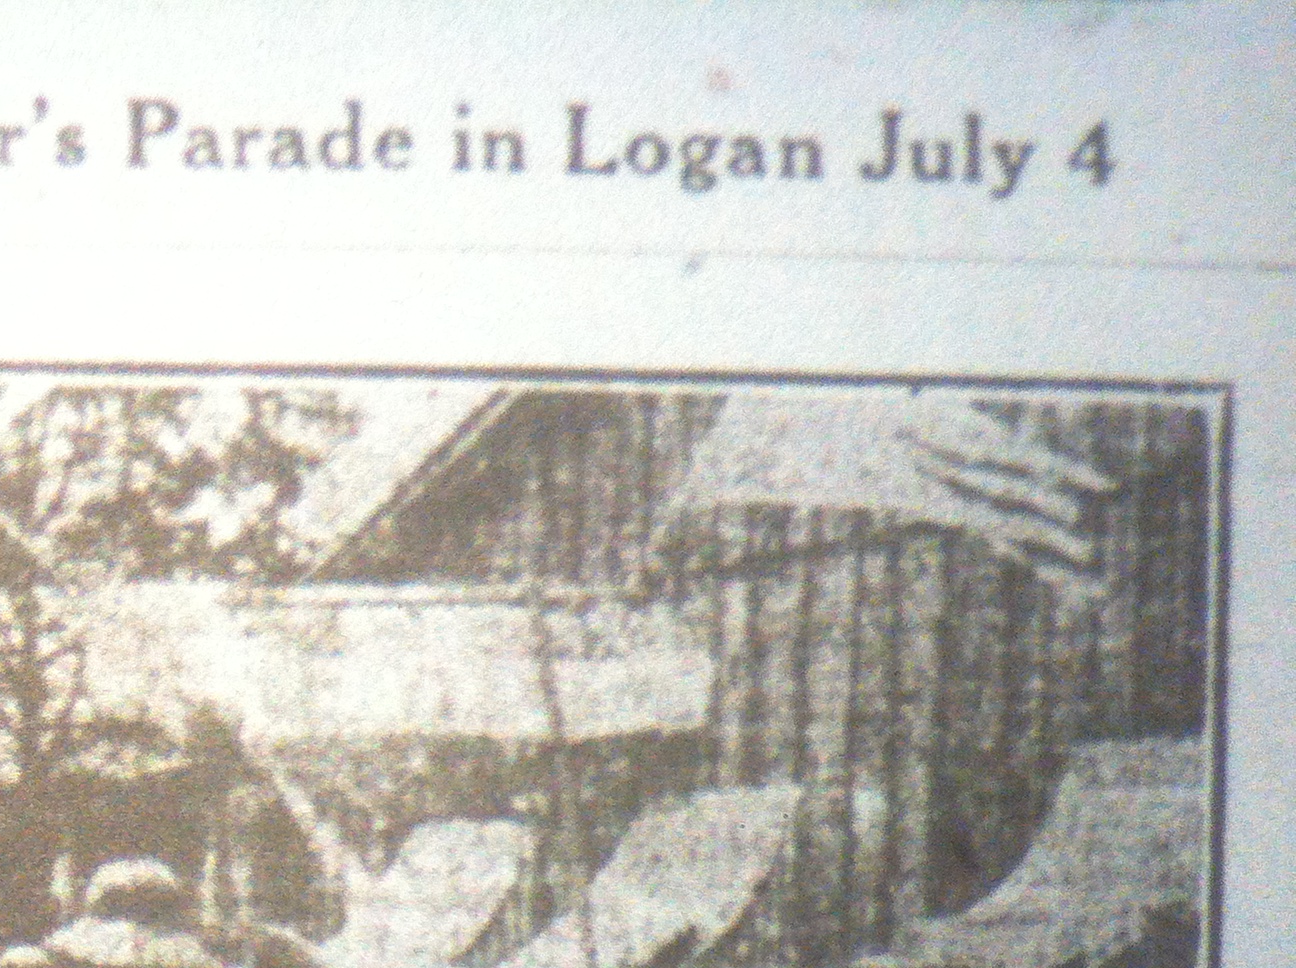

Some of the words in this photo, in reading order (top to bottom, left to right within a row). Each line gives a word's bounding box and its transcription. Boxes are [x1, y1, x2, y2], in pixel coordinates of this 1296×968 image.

[125, 97, 414, 172] Parade
[452, 102, 527, 175] in
[564, 102, 825, 194] Logan
[857, 108, 1036, 200] July
[1066, 119, 1118, 189] 4
